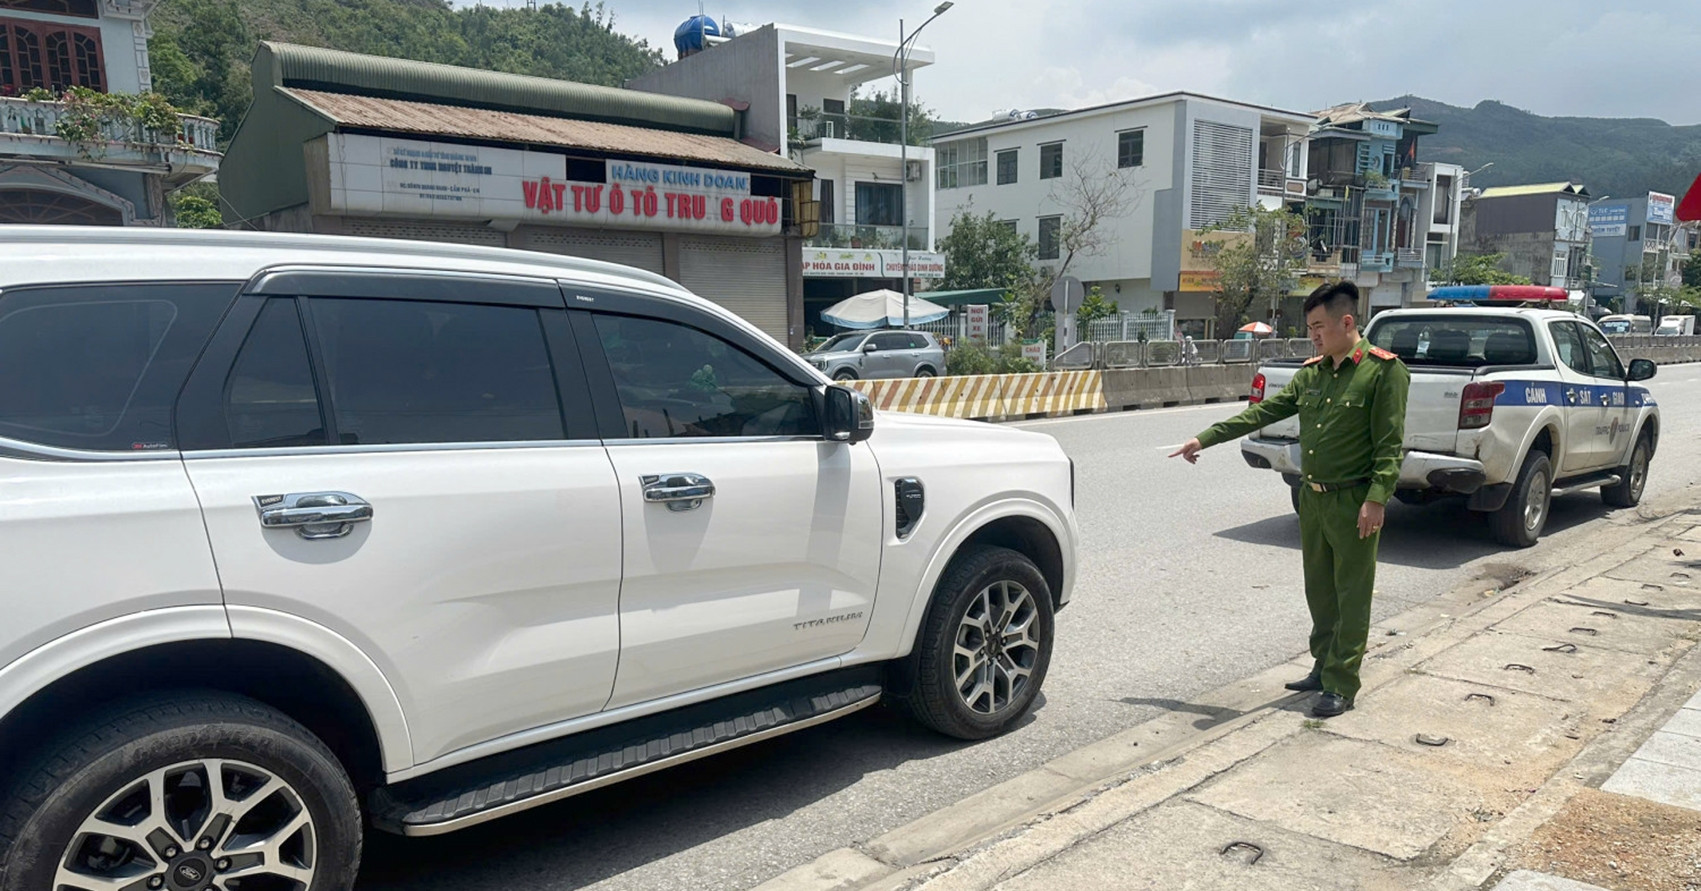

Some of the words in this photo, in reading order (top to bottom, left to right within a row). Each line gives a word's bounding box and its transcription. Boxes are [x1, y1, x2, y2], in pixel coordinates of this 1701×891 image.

[612, 164, 659, 184] HÀNG
[663, 170, 700, 188] KINH
[522, 176, 565, 214] VẬT
[571, 184, 604, 213] TƯ
[609, 182, 624, 215] Ô
[631, 185, 658, 217] TÔ
[664, 192, 735, 222] TRUG
[834, 262, 850, 270] GIA
[794, 611, 863, 631] TITANIUM
